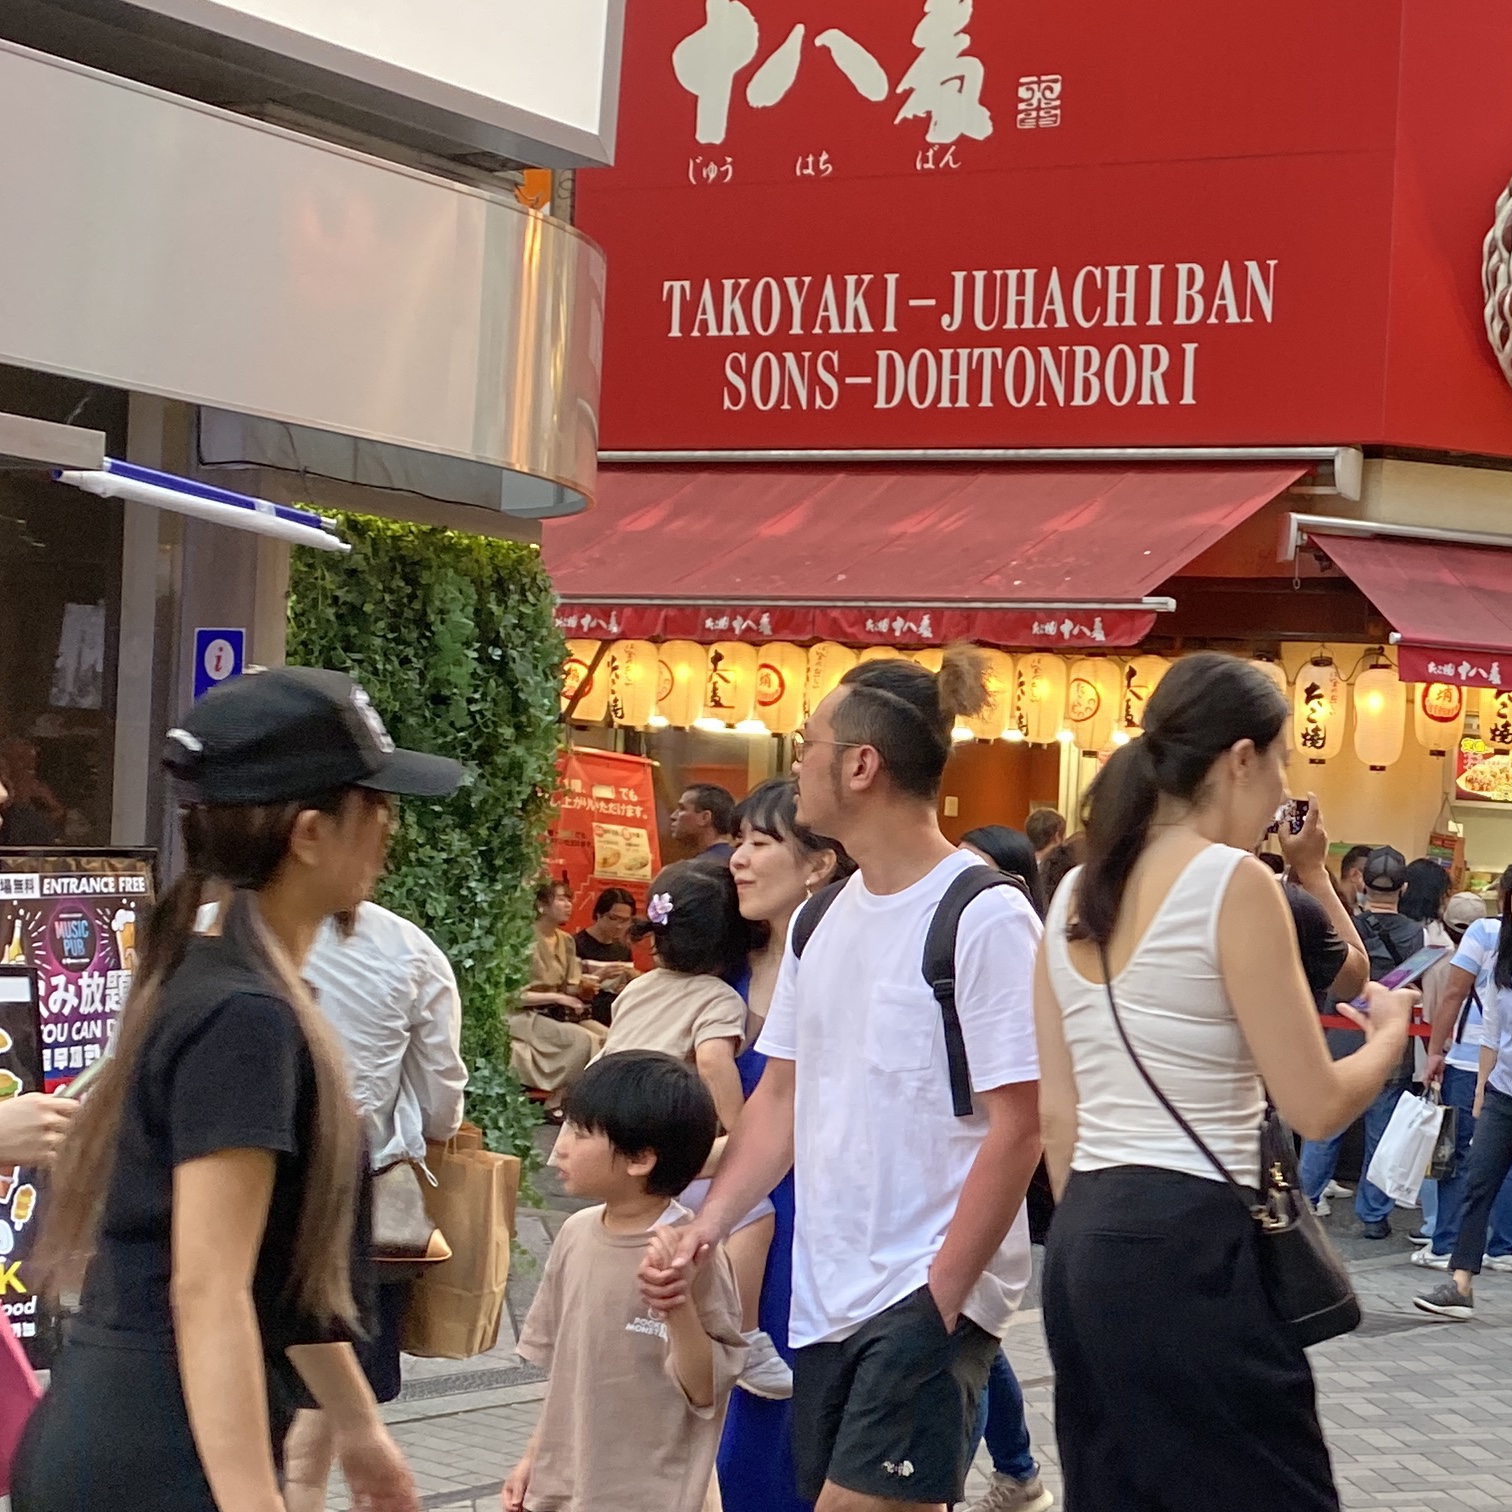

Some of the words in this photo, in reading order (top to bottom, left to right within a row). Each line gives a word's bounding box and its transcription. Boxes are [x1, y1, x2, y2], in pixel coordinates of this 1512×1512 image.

[686, 154, 734, 185] じゅう
[795, 149, 834, 177] はち
[915, 145, 962, 171] ばん
[662, 260, 1278, 338] TAKOYAKI-JUHACHIBAN
[722, 343, 1200, 411] SONS-DOHTONBORI
[42, 877, 116, 894] ENTRANCE
[118, 876, 146, 892] FREE
[54, 919, 90, 939] MUSIC
[62, 938, 86, 957] PUB
[41, 1023, 68, 1043] OU
[71, 1019, 102, 1041] CAN
